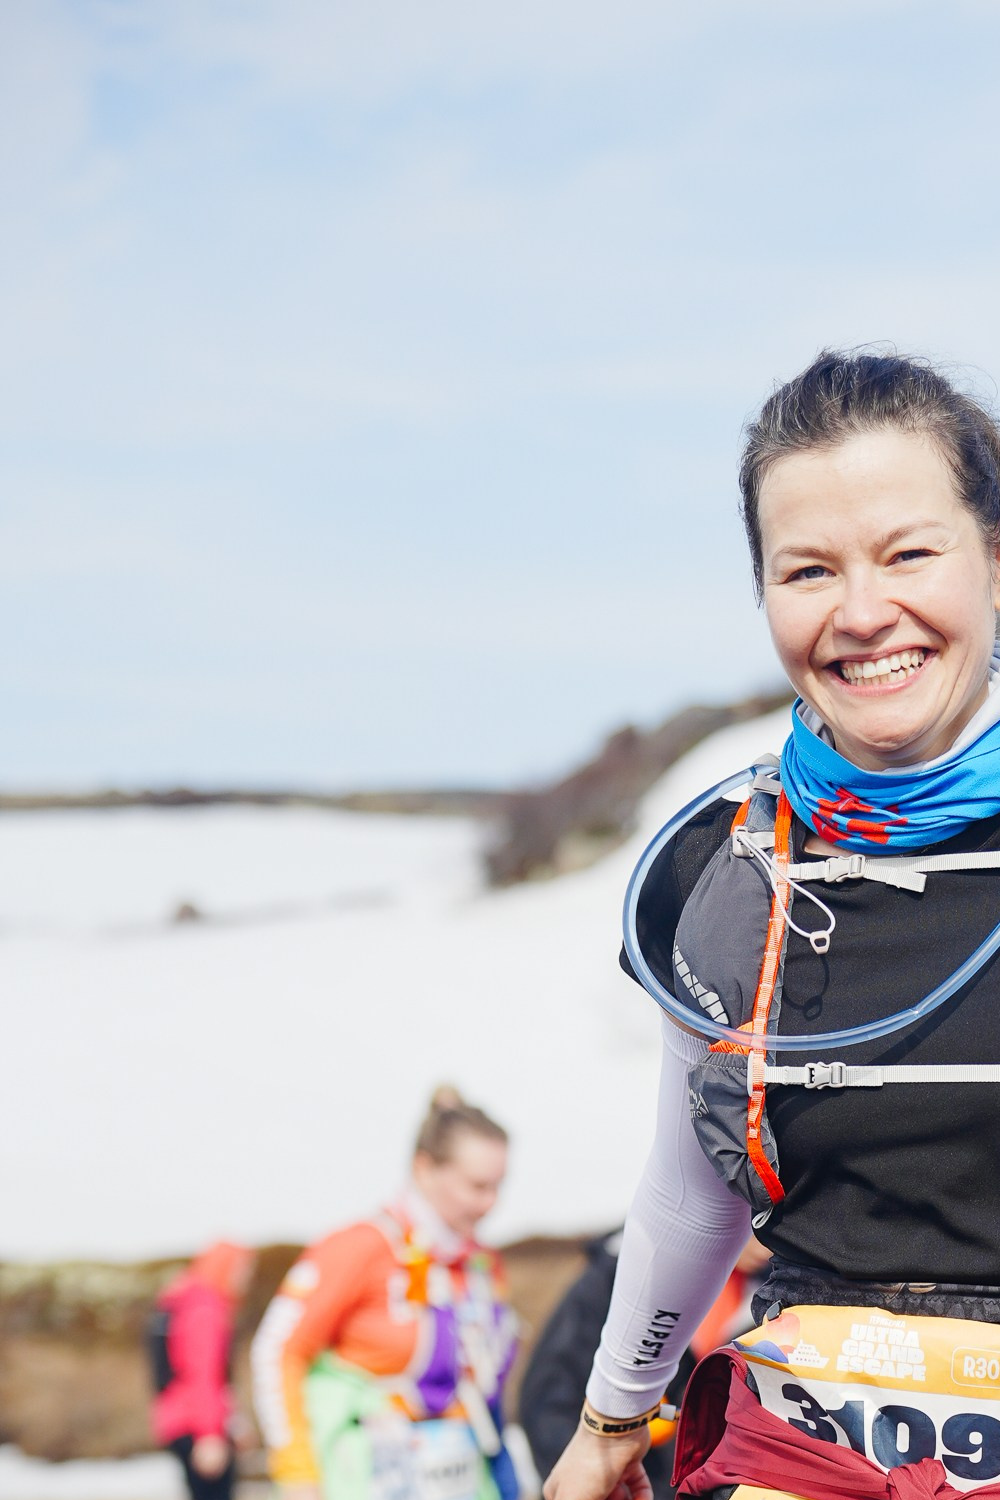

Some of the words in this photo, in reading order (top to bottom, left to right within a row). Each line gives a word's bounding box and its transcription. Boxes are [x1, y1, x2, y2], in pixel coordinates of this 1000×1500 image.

[850, 1323, 921, 1349] ULTRA
[841, 1338, 925, 1365] GRAND
[836, 1354, 927, 1382] ESCAPE
[963, 1355, 1000, 1381] R30
